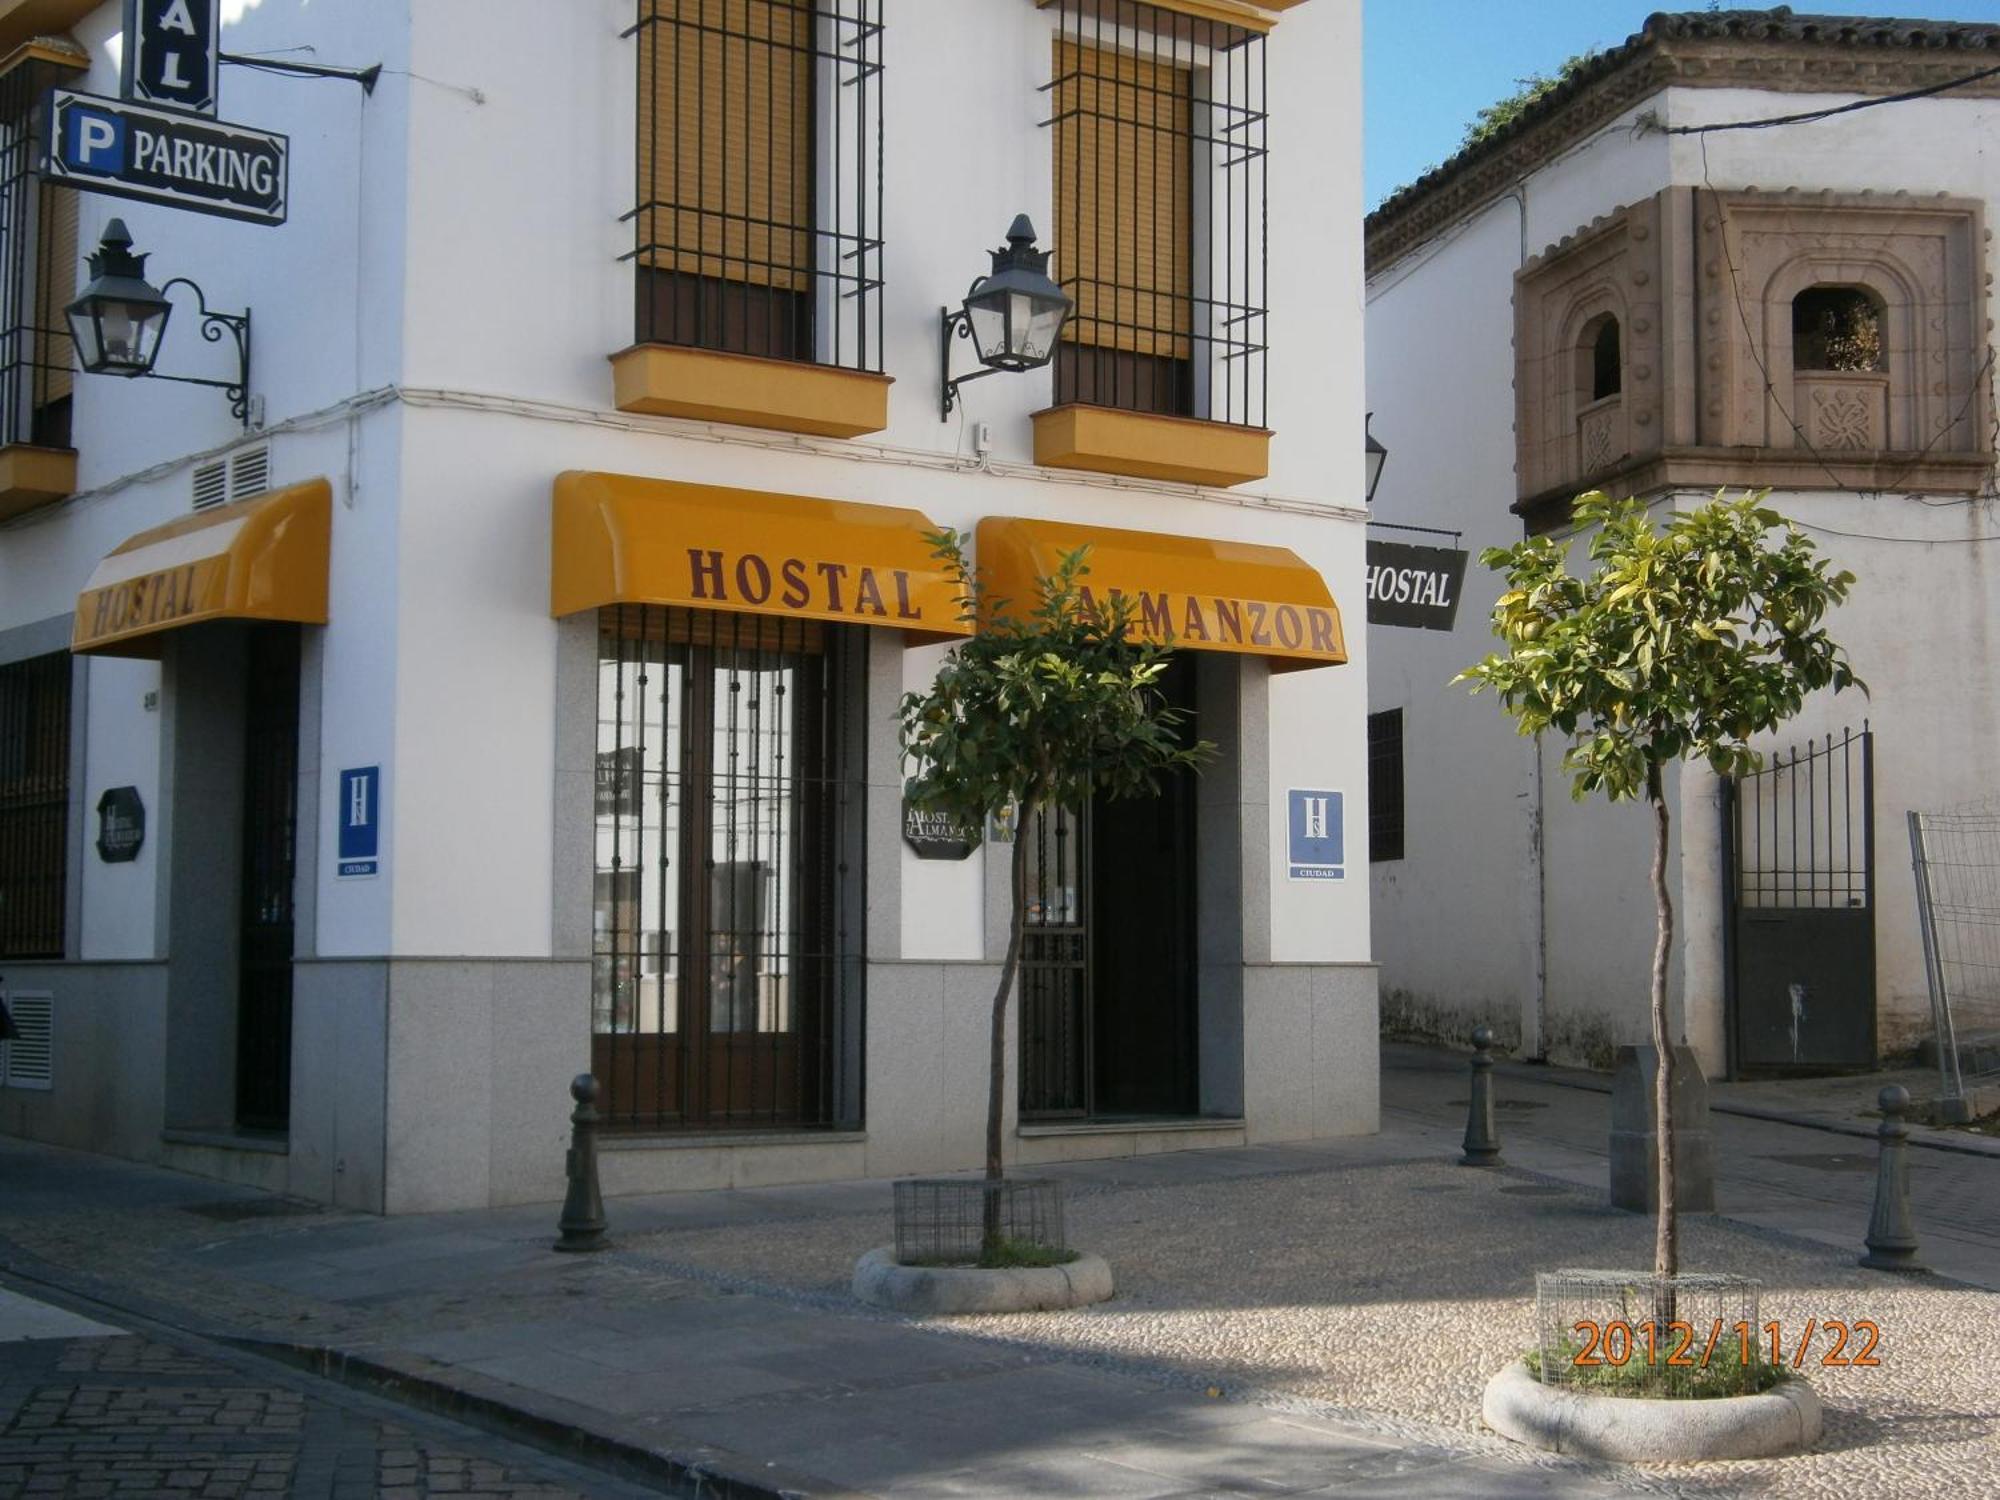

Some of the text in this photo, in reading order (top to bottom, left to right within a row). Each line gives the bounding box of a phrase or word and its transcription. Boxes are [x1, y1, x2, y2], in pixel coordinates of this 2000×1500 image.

[79, 115, 274, 196] P PARKING
[93, 565, 195, 639] HOSTAL
[686, 548, 922, 620] HOSTAL
[1365, 564, 1451, 607] HOSTAL
[1299, 869, 1335, 878] CIUDAD
